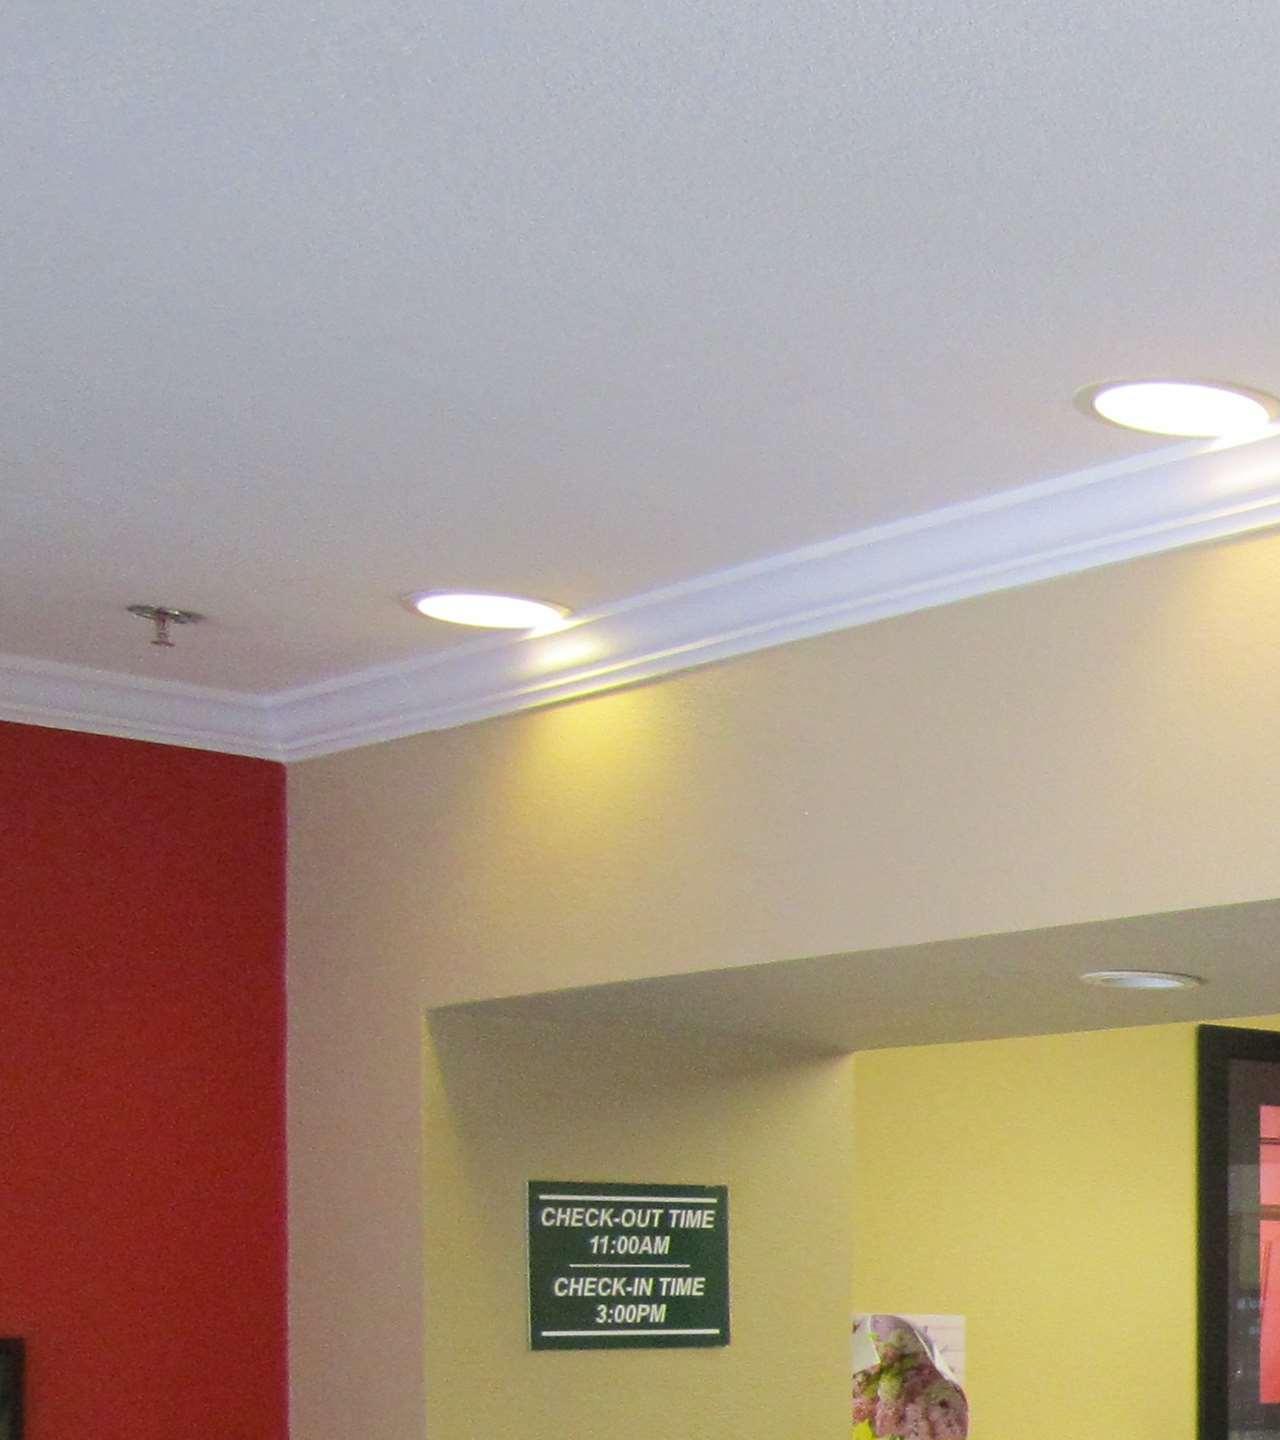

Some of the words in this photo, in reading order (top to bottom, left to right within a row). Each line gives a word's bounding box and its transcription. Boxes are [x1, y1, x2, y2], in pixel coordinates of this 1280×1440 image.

[540, 1207, 663, 1228] CHECK-OUT
[669, 1209, 715, 1229] TIME
[589, 1235, 671, 1255] 11:00AM
[554, 1277, 653, 1297] CHECK-IN
[659, 1277, 706, 1296] TIME
[595, 1304, 667, 1323] 3:00PM
